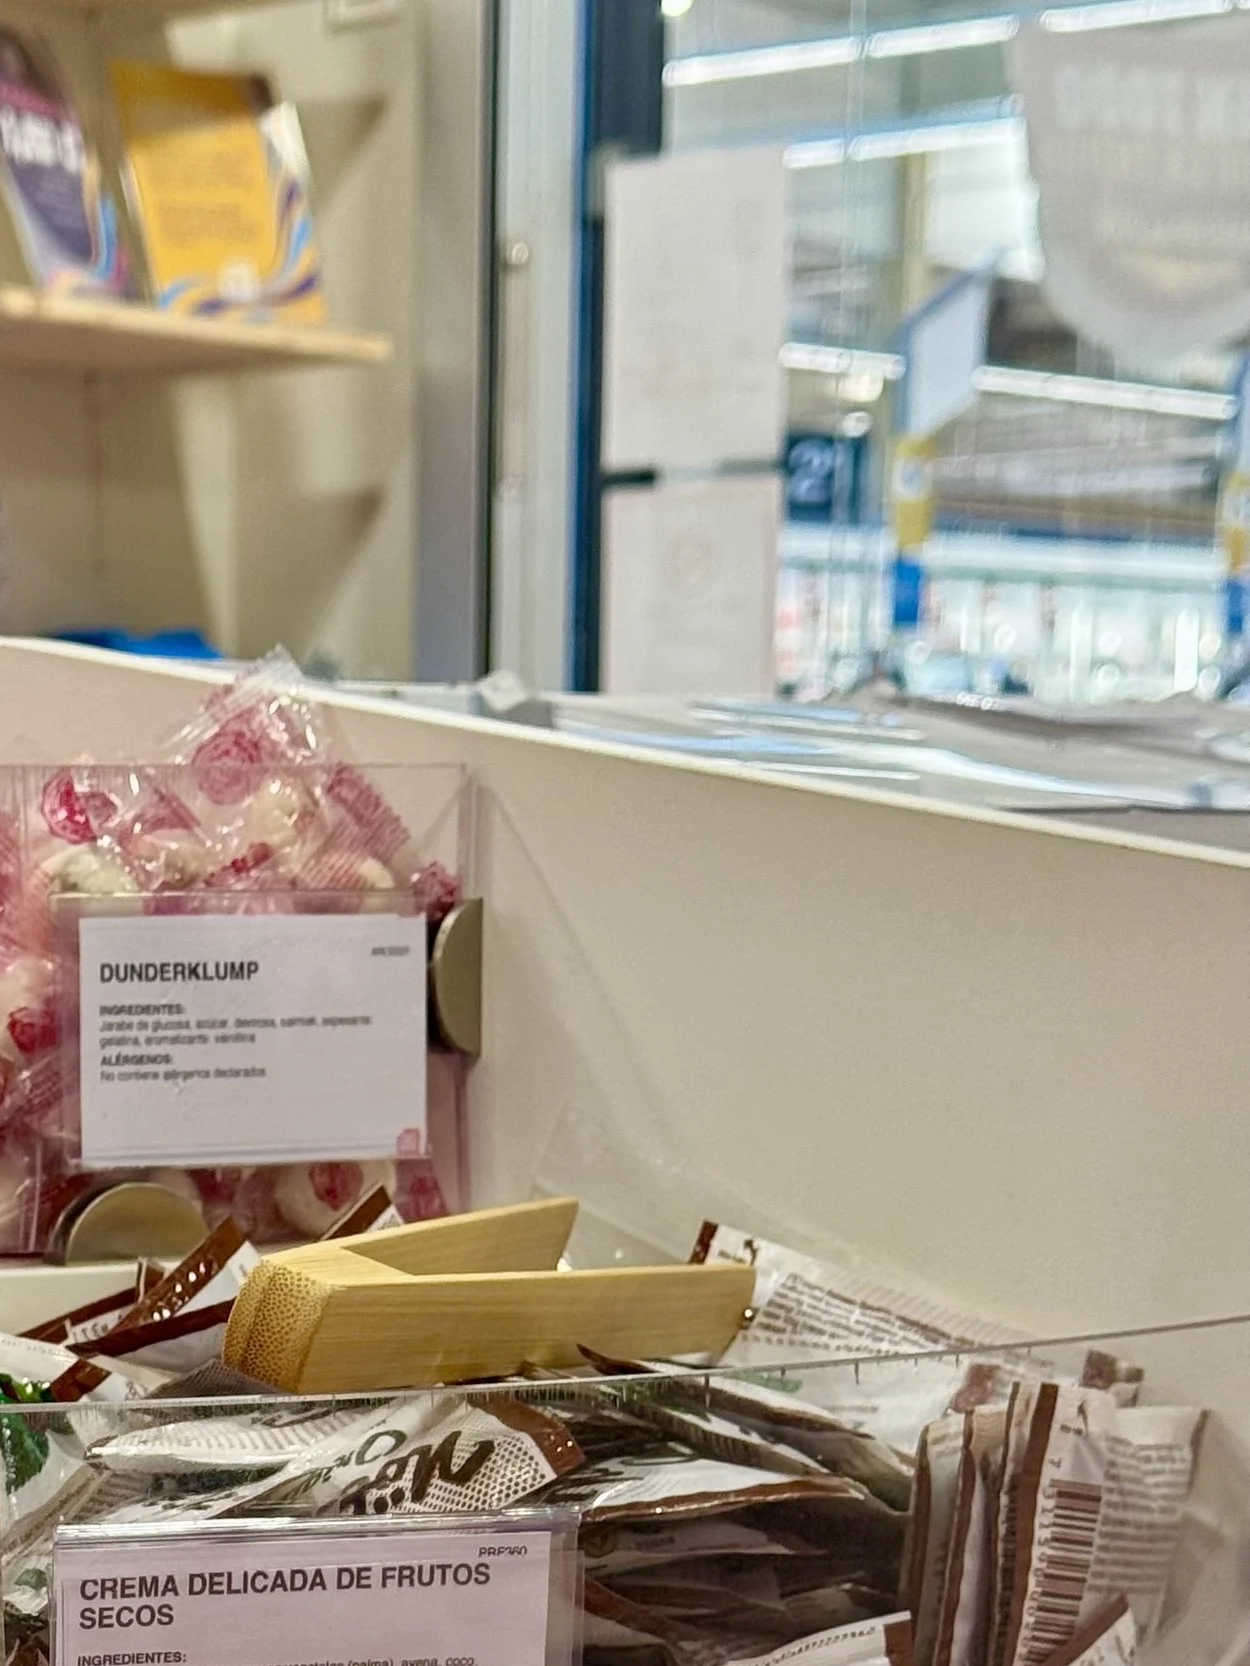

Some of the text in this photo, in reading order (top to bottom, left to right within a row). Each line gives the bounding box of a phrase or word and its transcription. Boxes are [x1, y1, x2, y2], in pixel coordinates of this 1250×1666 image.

[100, 960, 259, 984] DUNDERKLUMP
[80, 1562, 490, 1601] CREMA DELICADA DE FRUTOS
[79, 1603, 174, 1630] SECOS
